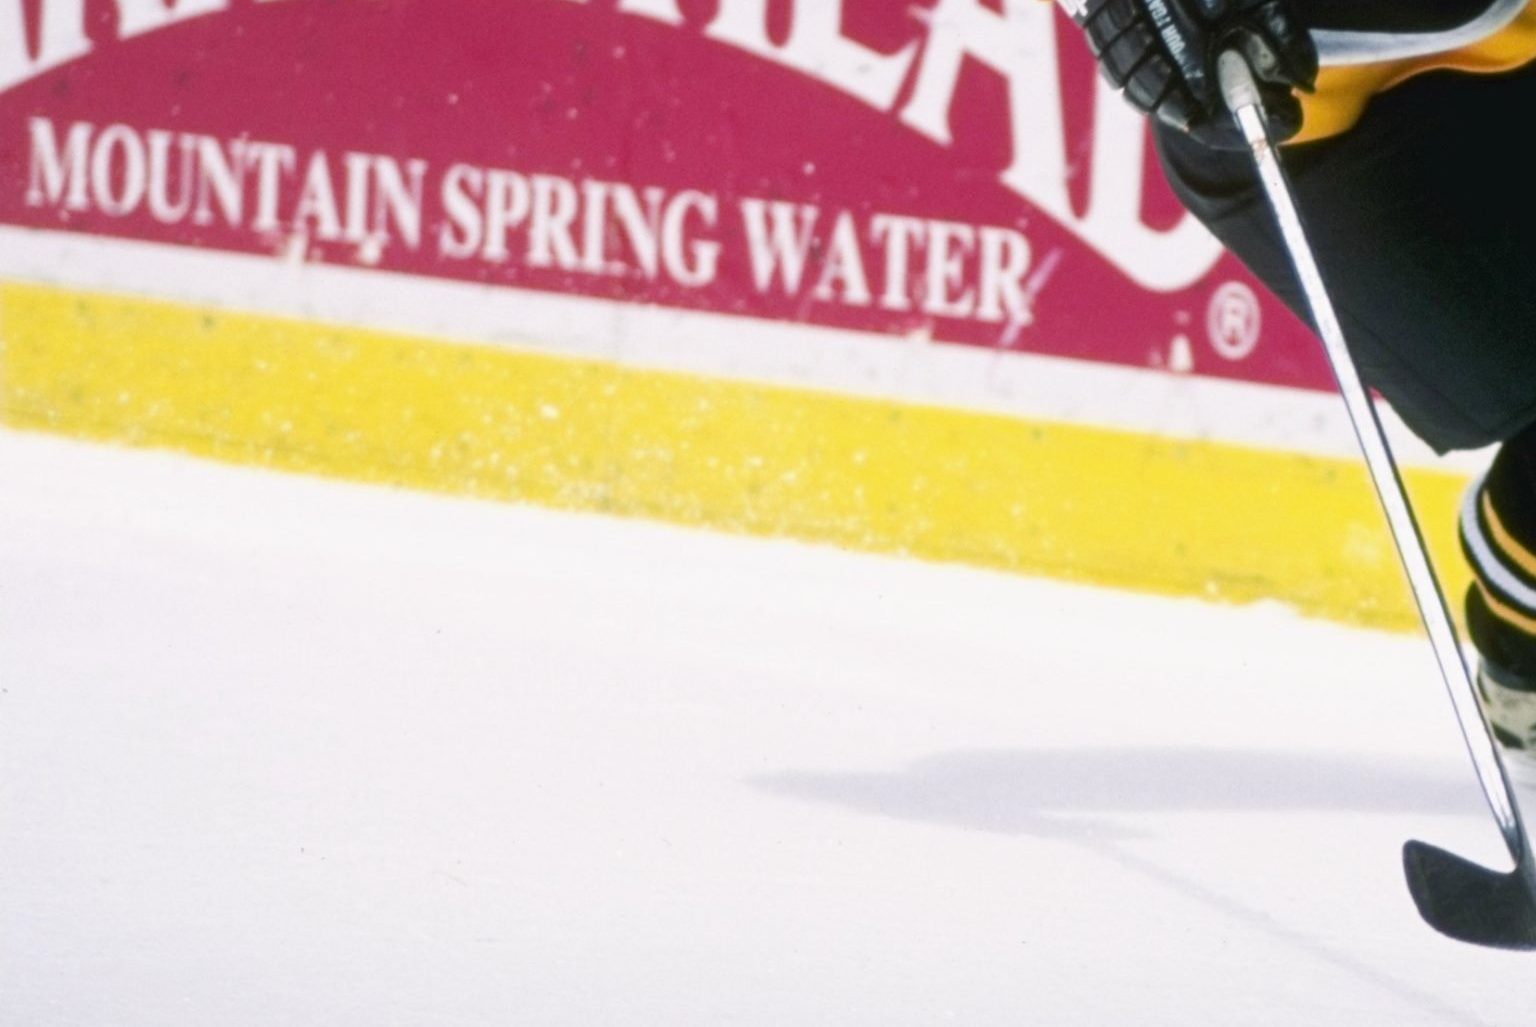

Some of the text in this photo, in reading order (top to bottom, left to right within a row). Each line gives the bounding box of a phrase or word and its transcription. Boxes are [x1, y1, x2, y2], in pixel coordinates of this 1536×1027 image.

[26, 116, 1034, 326] MOUNTAIN SPRING WATER
